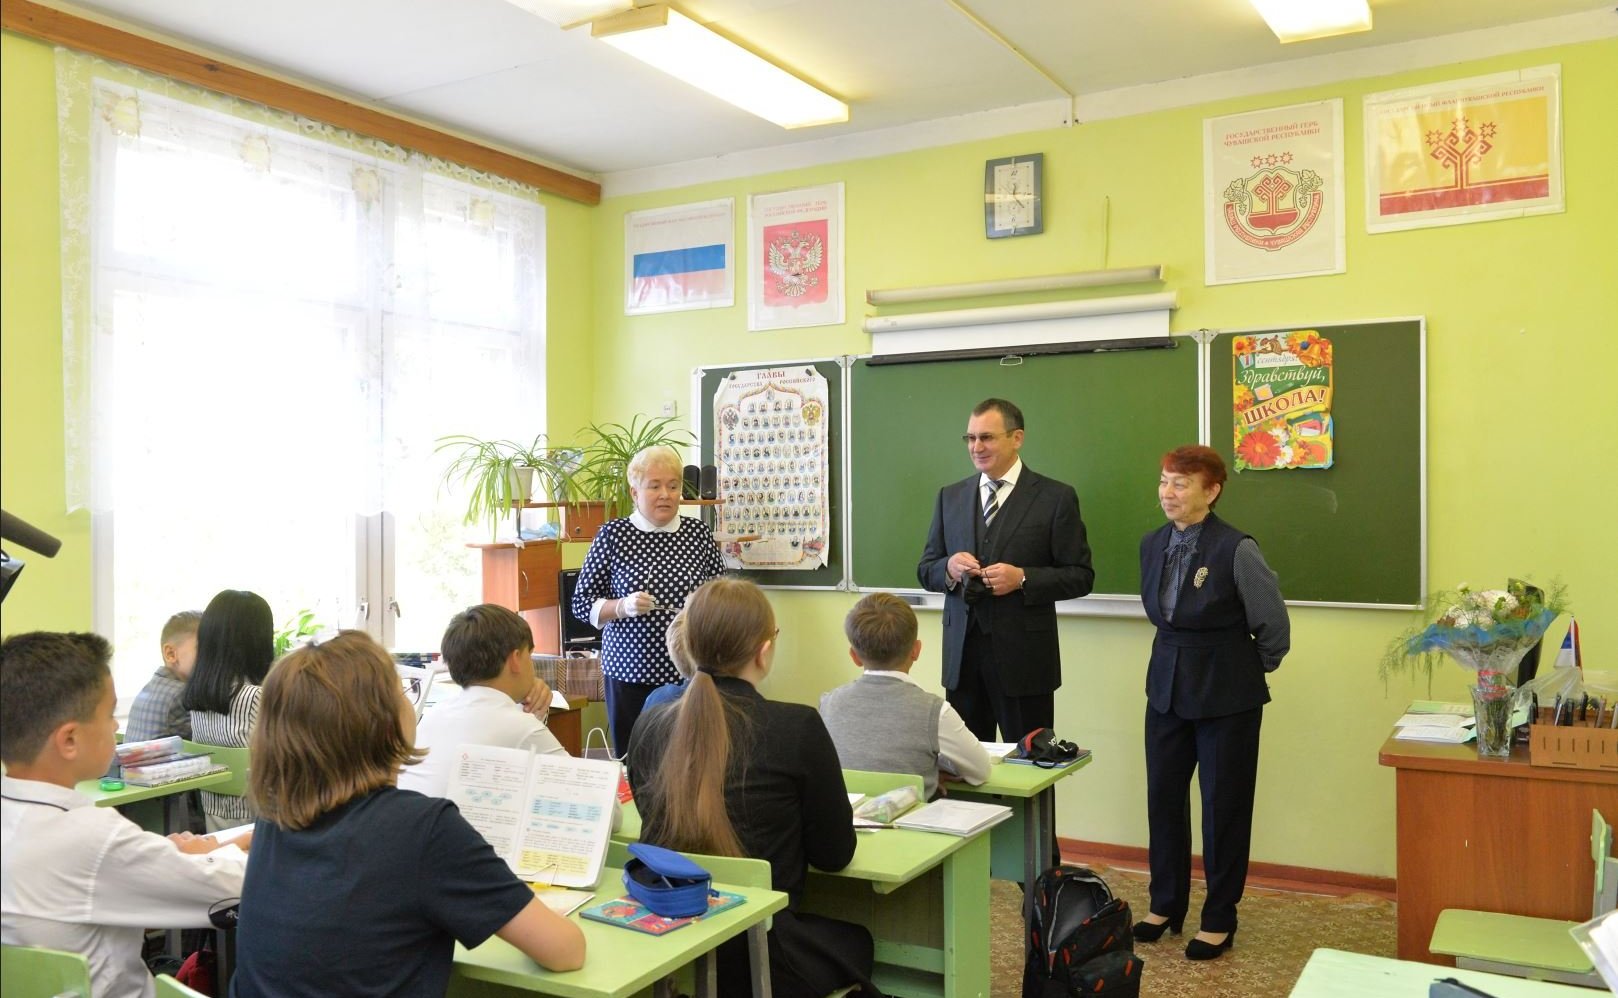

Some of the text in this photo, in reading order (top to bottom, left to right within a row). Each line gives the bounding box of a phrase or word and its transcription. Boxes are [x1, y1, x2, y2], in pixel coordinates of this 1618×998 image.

[757, 371, 785, 380] ГЛАВЫ
[1238, 365, 1326, 391] Здравствуй,
[1243, 389, 1326, 425] ШКОЛА!
